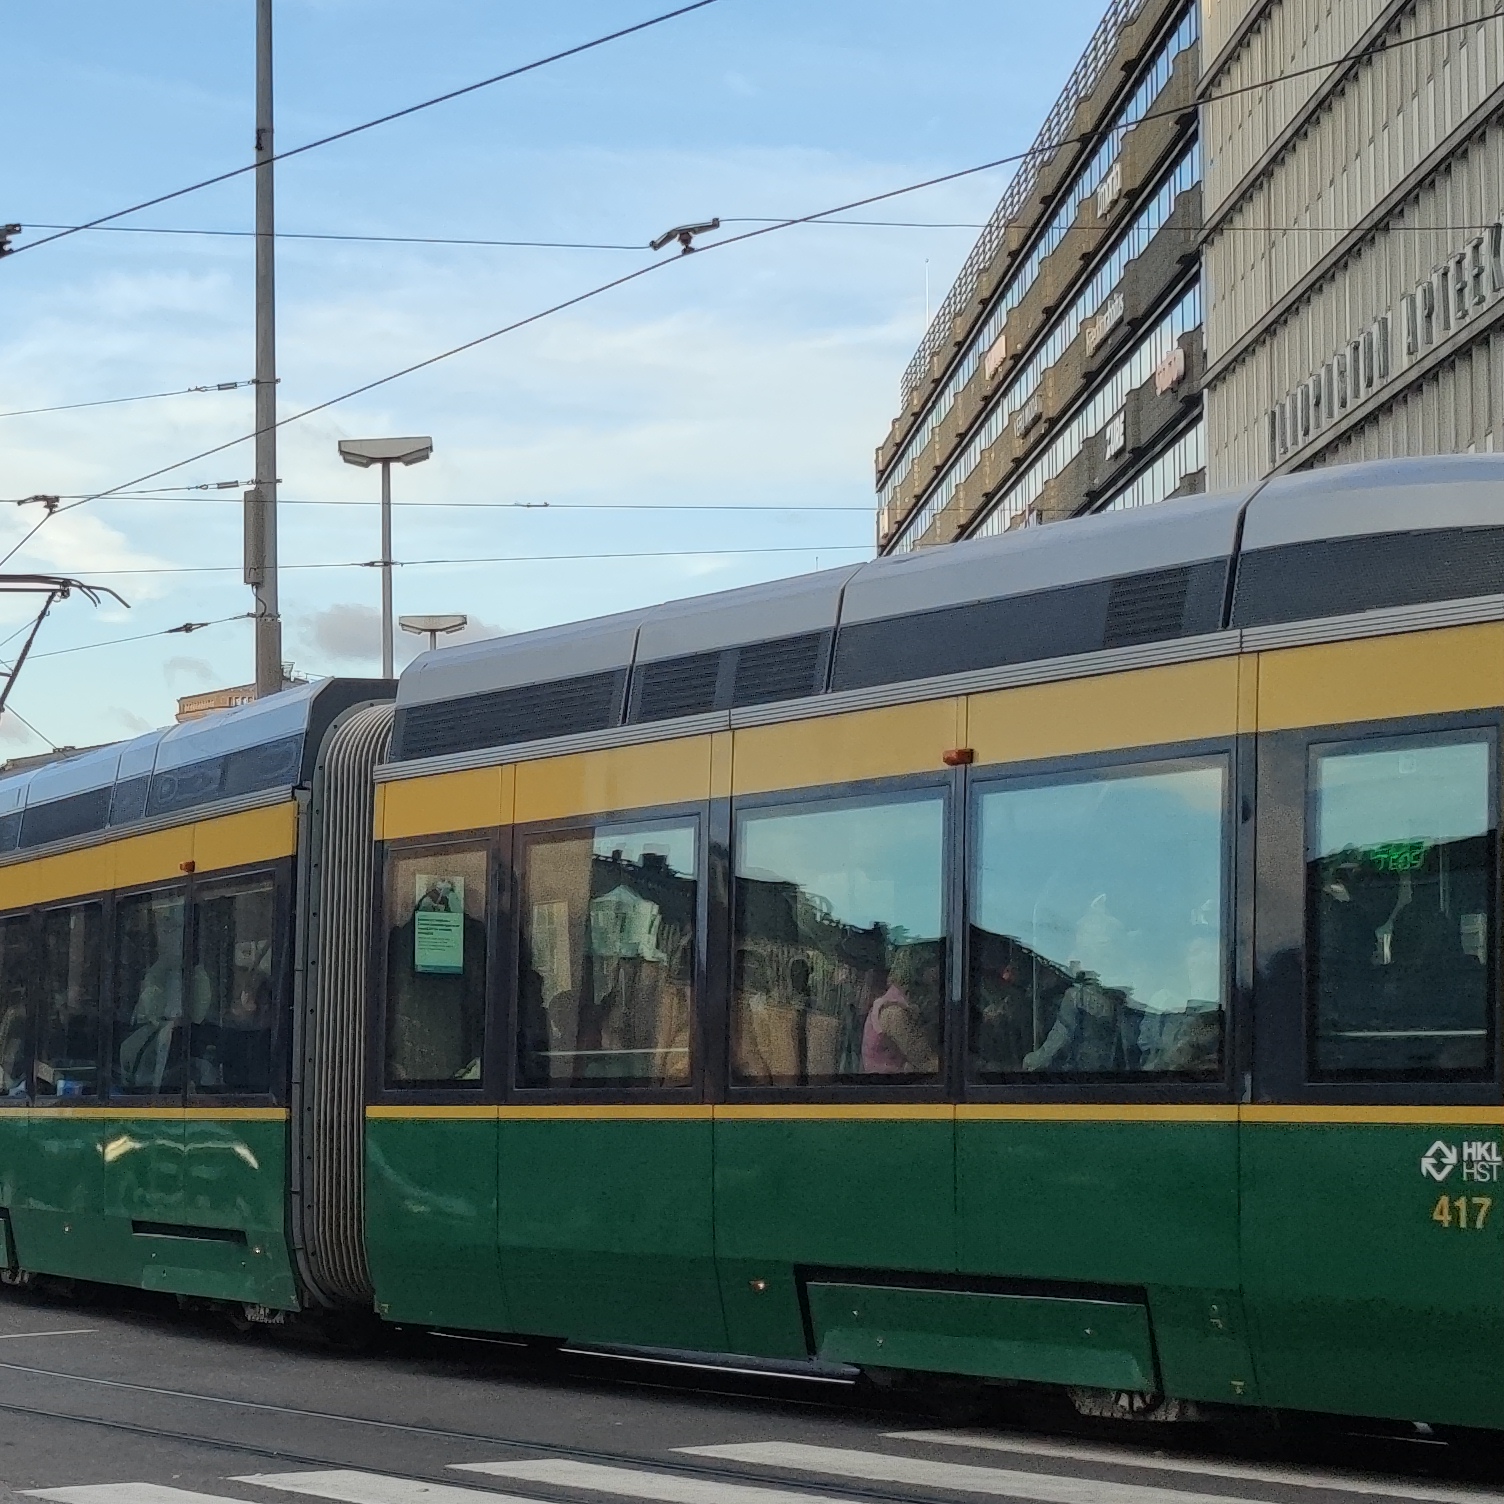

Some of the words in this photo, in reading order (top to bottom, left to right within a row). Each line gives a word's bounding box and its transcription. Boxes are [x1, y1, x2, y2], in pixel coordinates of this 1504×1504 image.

[1462, 1141, 1502, 1161] HKL
[1462, 1161, 1500, 1182] HST
[1432, 1195, 1491, 1229] 417
